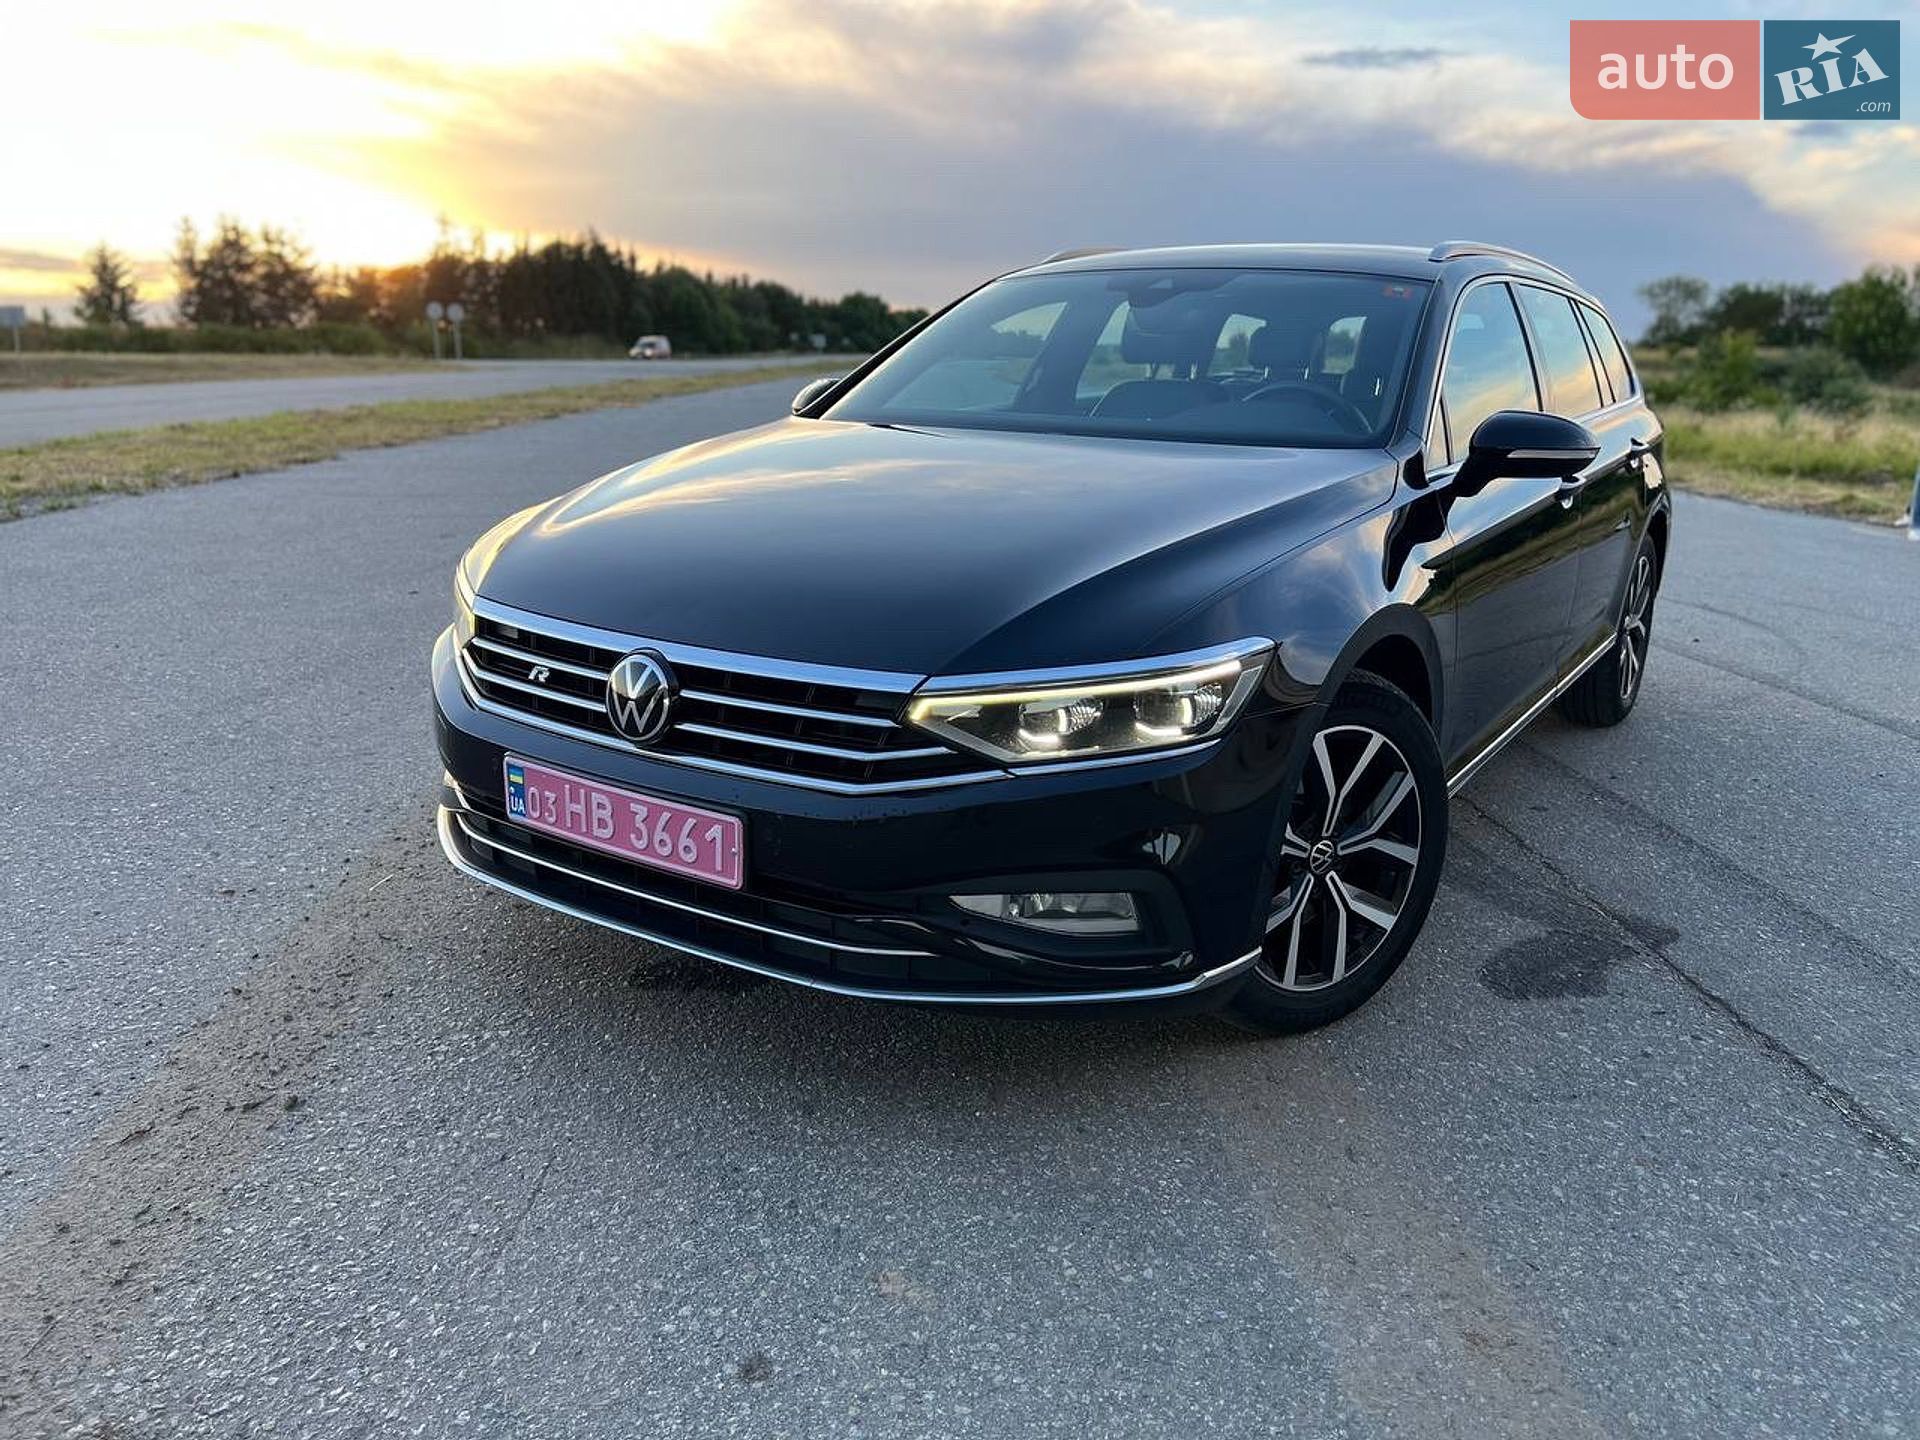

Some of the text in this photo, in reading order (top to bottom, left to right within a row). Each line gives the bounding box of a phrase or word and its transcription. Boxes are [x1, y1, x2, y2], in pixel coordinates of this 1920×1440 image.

[528, 666, 550, 683] R
[511, 792, 526, 815] UA
[630, 803, 723, 872] 3661
